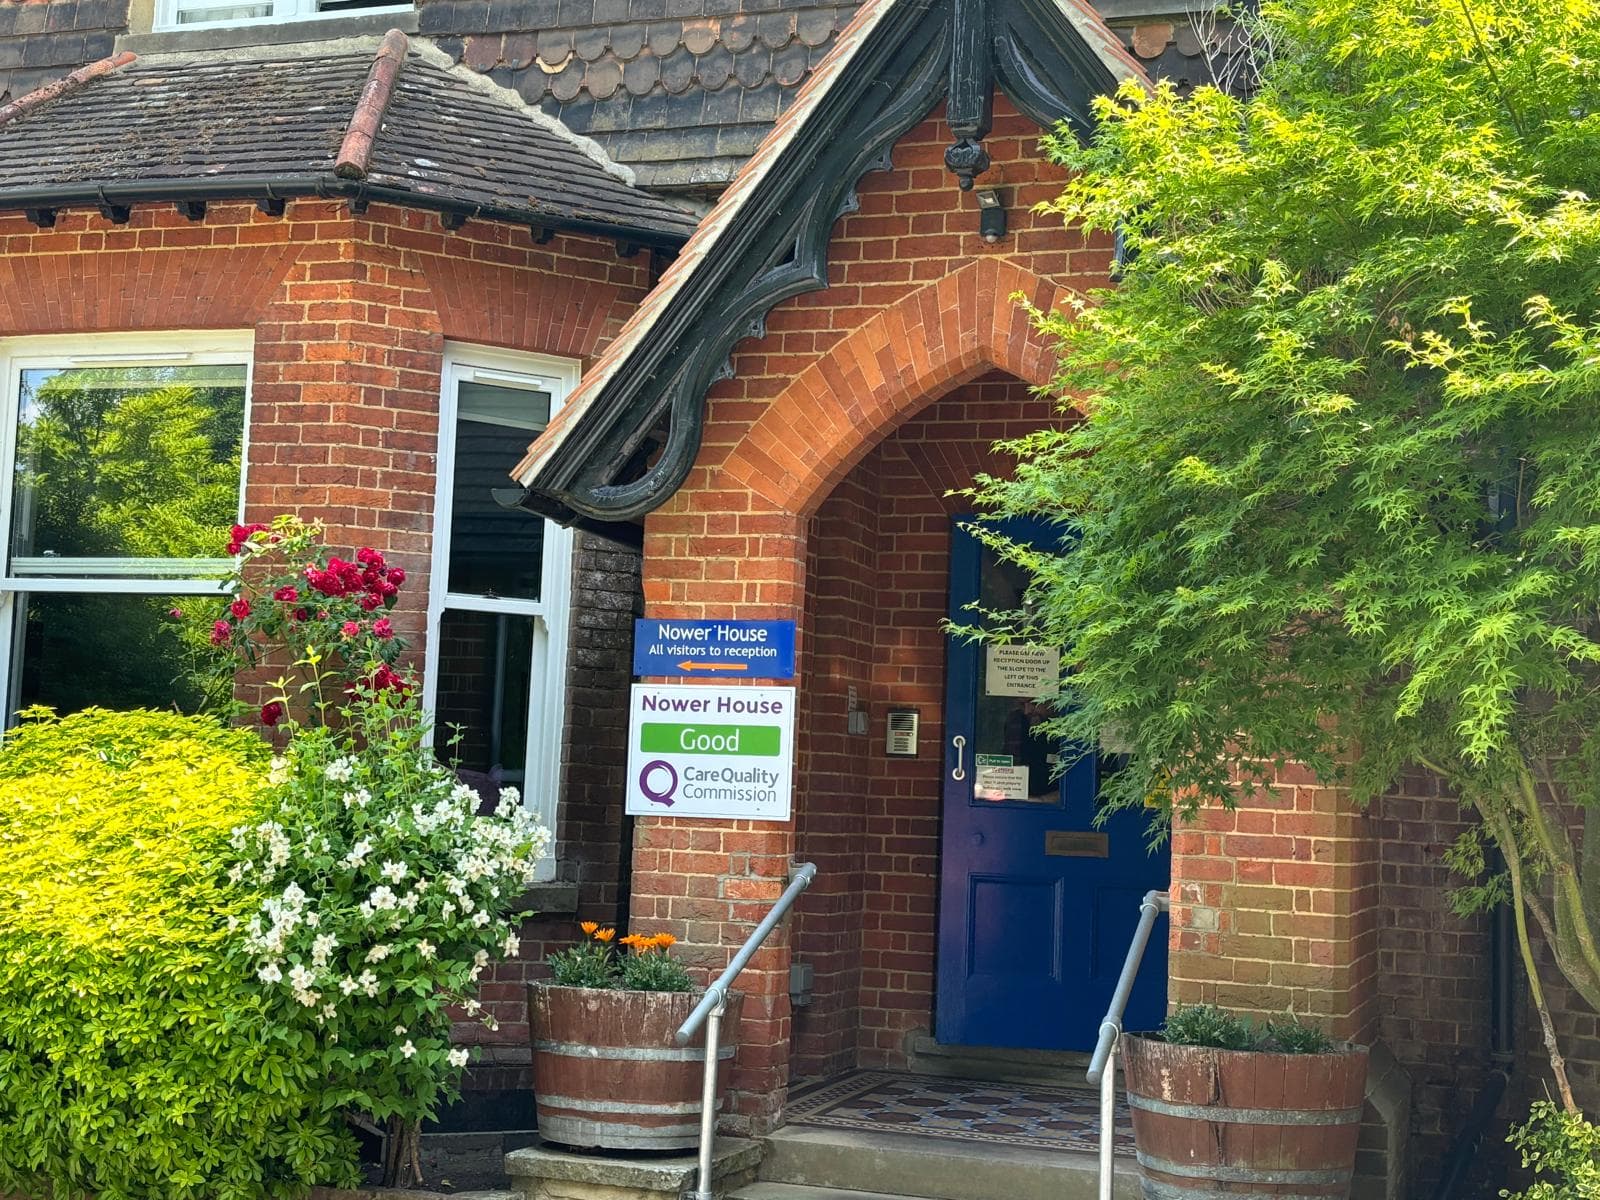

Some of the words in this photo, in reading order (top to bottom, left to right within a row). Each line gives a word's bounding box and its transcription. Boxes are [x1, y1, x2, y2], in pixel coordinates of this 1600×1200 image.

[658, 624, 711, 641] Nower
[717, 625, 768, 642] House
[649, 646, 665, 656] All
[666, 645, 706, 656] visitors
[709, 647, 721, 657] to
[724, 647, 777, 659] reception
[642, 695, 711, 713] Nower
[717, 697, 783, 714] House
[680, 728, 740, 752] Good
[683, 784, 777, 803] Commission
